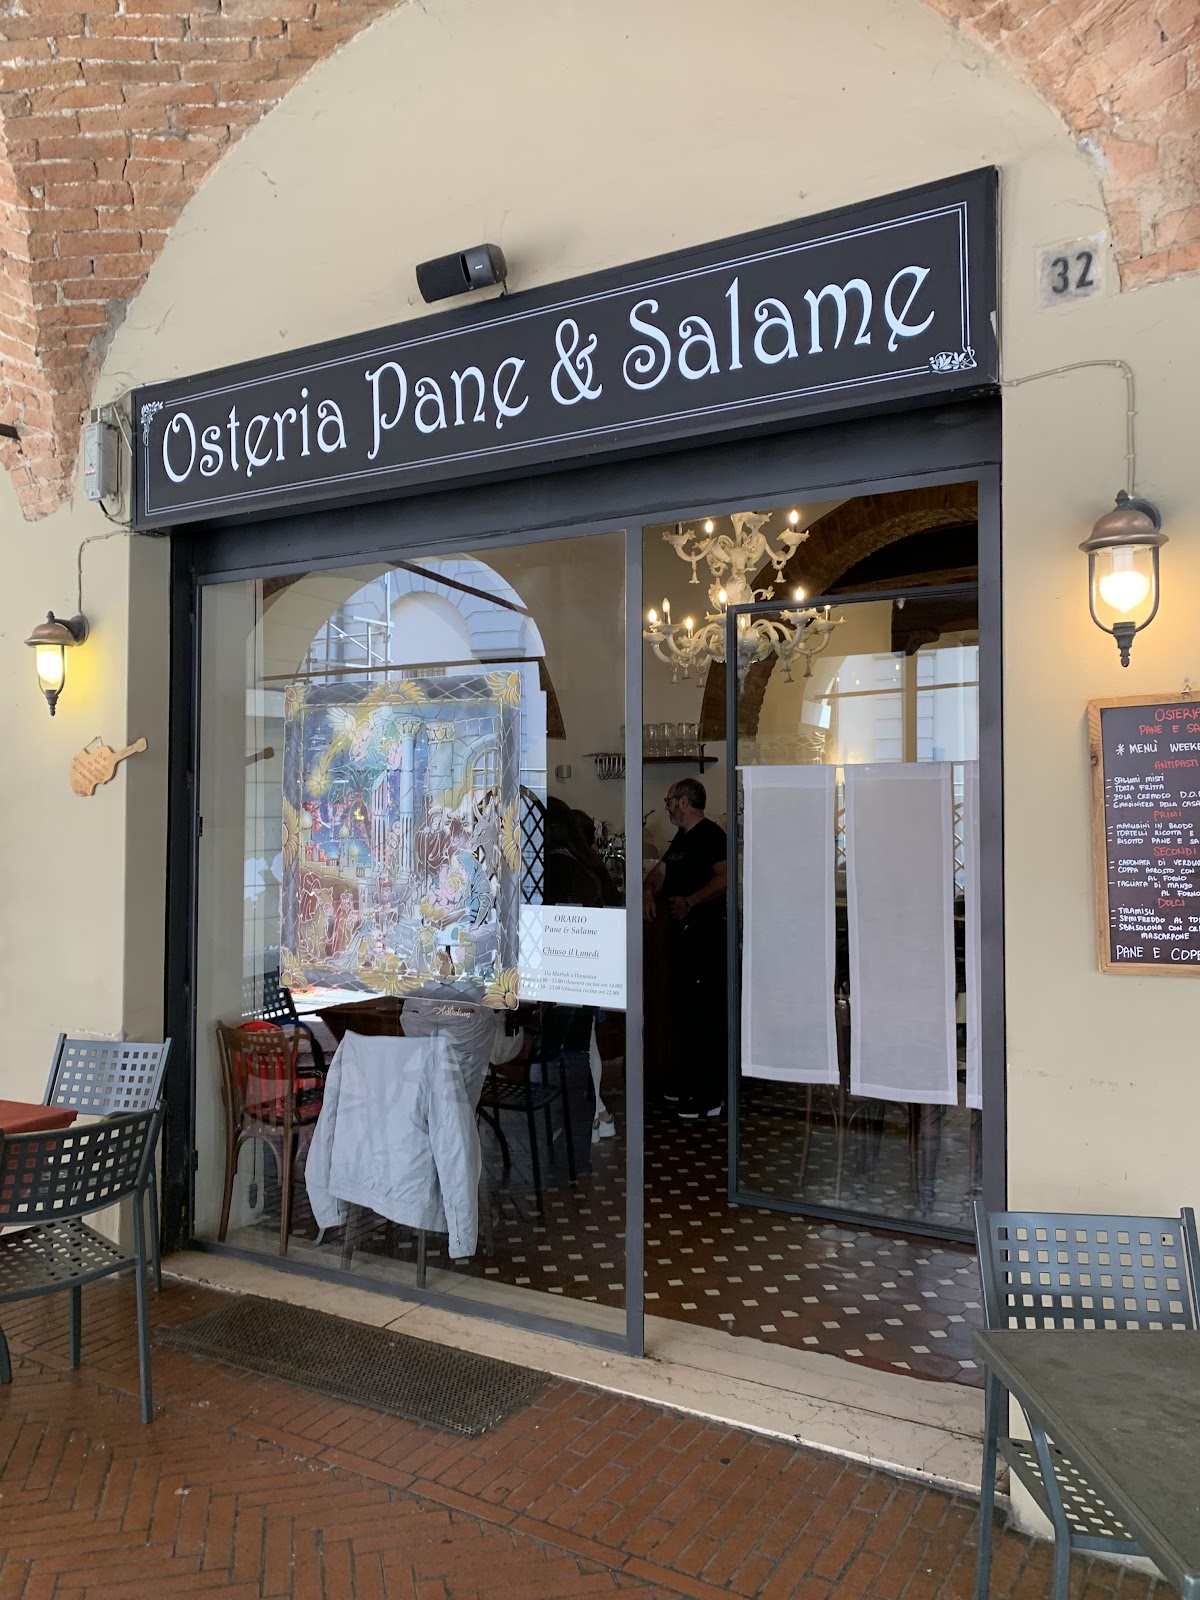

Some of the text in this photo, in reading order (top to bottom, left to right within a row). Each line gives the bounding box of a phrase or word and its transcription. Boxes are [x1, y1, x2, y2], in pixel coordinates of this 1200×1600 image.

[1051, 250, 1094, 294] 32
[162, 265, 935, 489] Osteria Pane & Salame
[1139, 724, 1163, 735] PANE
[1172, 725, 1180, 733] E
[1129, 740, 1158, 754] MENÙ
[1115, 783, 1164, 792] TORTA FRITTA
[1153, 809, 1182, 819] PRIMI
[1155, 821, 1163, 829] IN
[1153, 845, 1197, 856] SECONDI
[1117, 879, 1149, 887] TAGLIATA
[1157, 897, 1185, 908] DOLCI
[1118, 905, 1154, 915] TIRAMISU
[554, 914, 587, 923] ORARIO
[1119, 915, 1166, 923] SEMIFREDDO
[571, 926, 598, 935] Salame
[1119, 923, 1162, 931] SBRISOLONA
[1141, 932, 1190, 940] MASCARPONE
[542, 946, 567, 956] Chiuso
[568, 948, 573, 956] il
[1116, 944, 1144, 960] PANE
[1153, 947, 1161, 958] E
